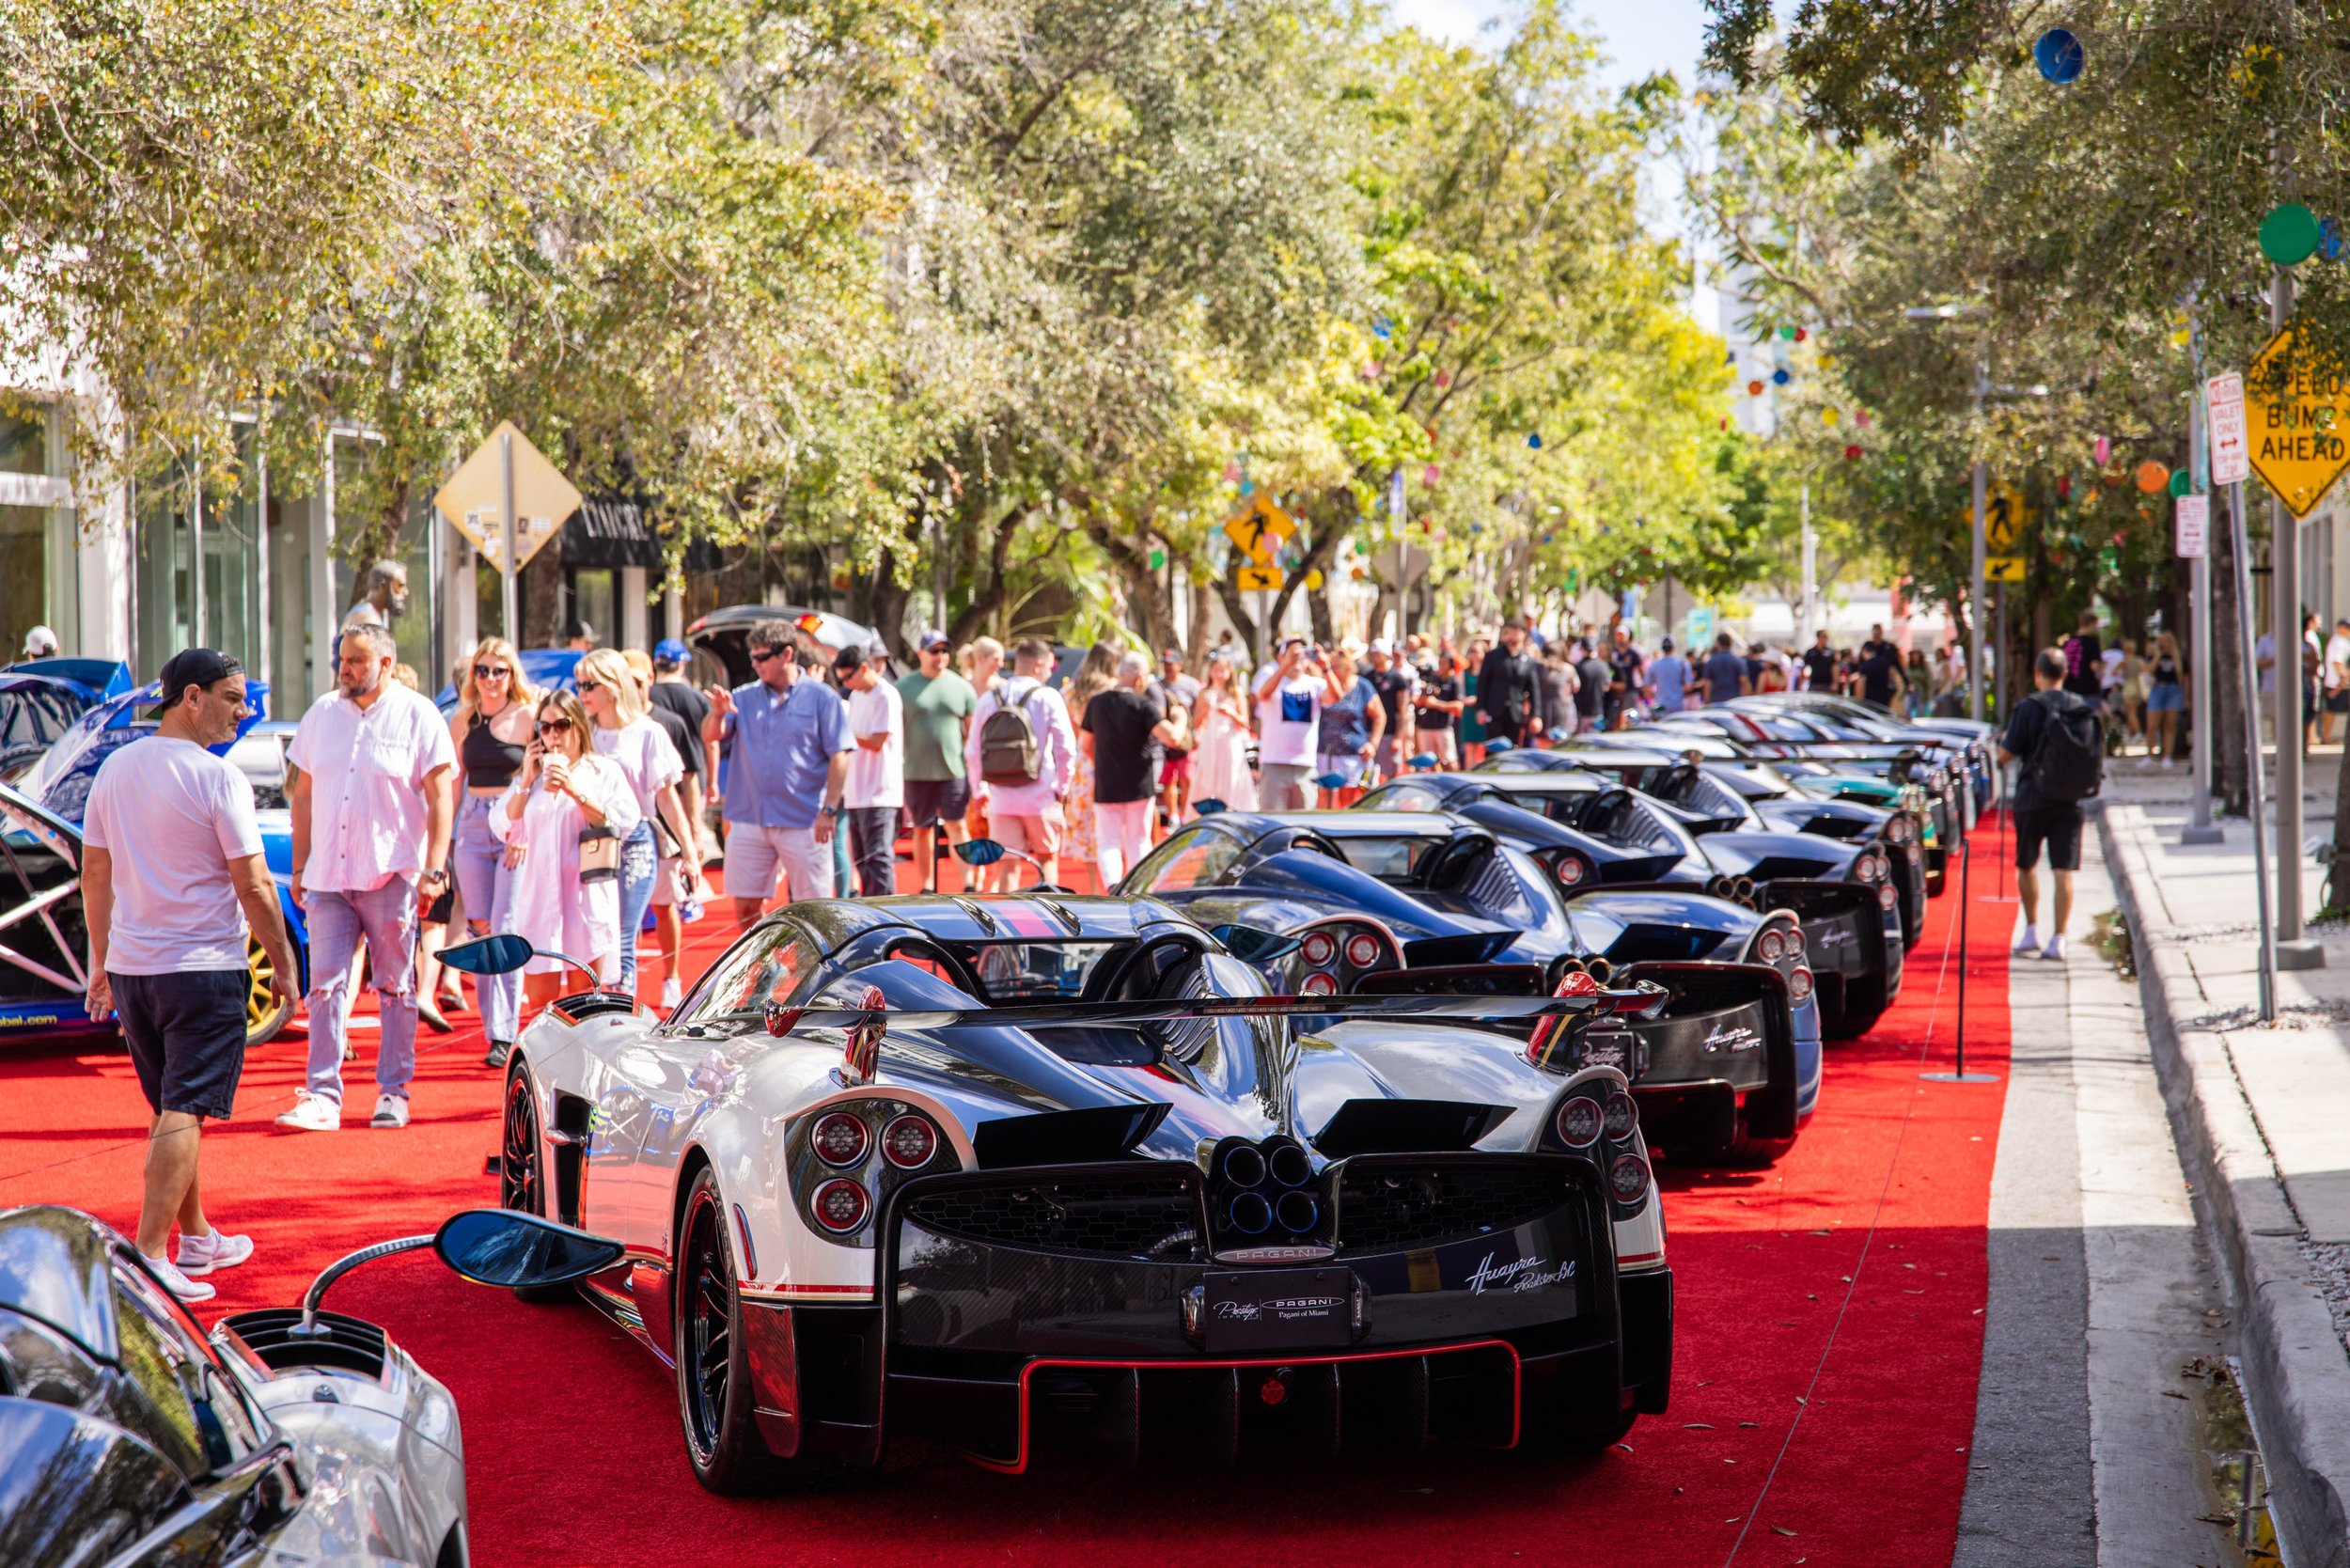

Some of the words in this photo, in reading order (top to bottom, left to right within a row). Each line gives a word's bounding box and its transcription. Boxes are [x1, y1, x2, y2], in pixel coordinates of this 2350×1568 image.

[2263, 370, 2342, 396] PEED
[2214, 405, 2241, 421] VALET
[2217, 421, 2239, 435] ONLY
[2260, 436, 2344, 461] AHEAD
[1236, 1248, 1317, 1260] PAGANI
[1465, 1251, 1547, 1296] Huayra
[1213, 1301, 1259, 1321] Prestige
[1276, 1298, 1332, 1308] PAGANI
